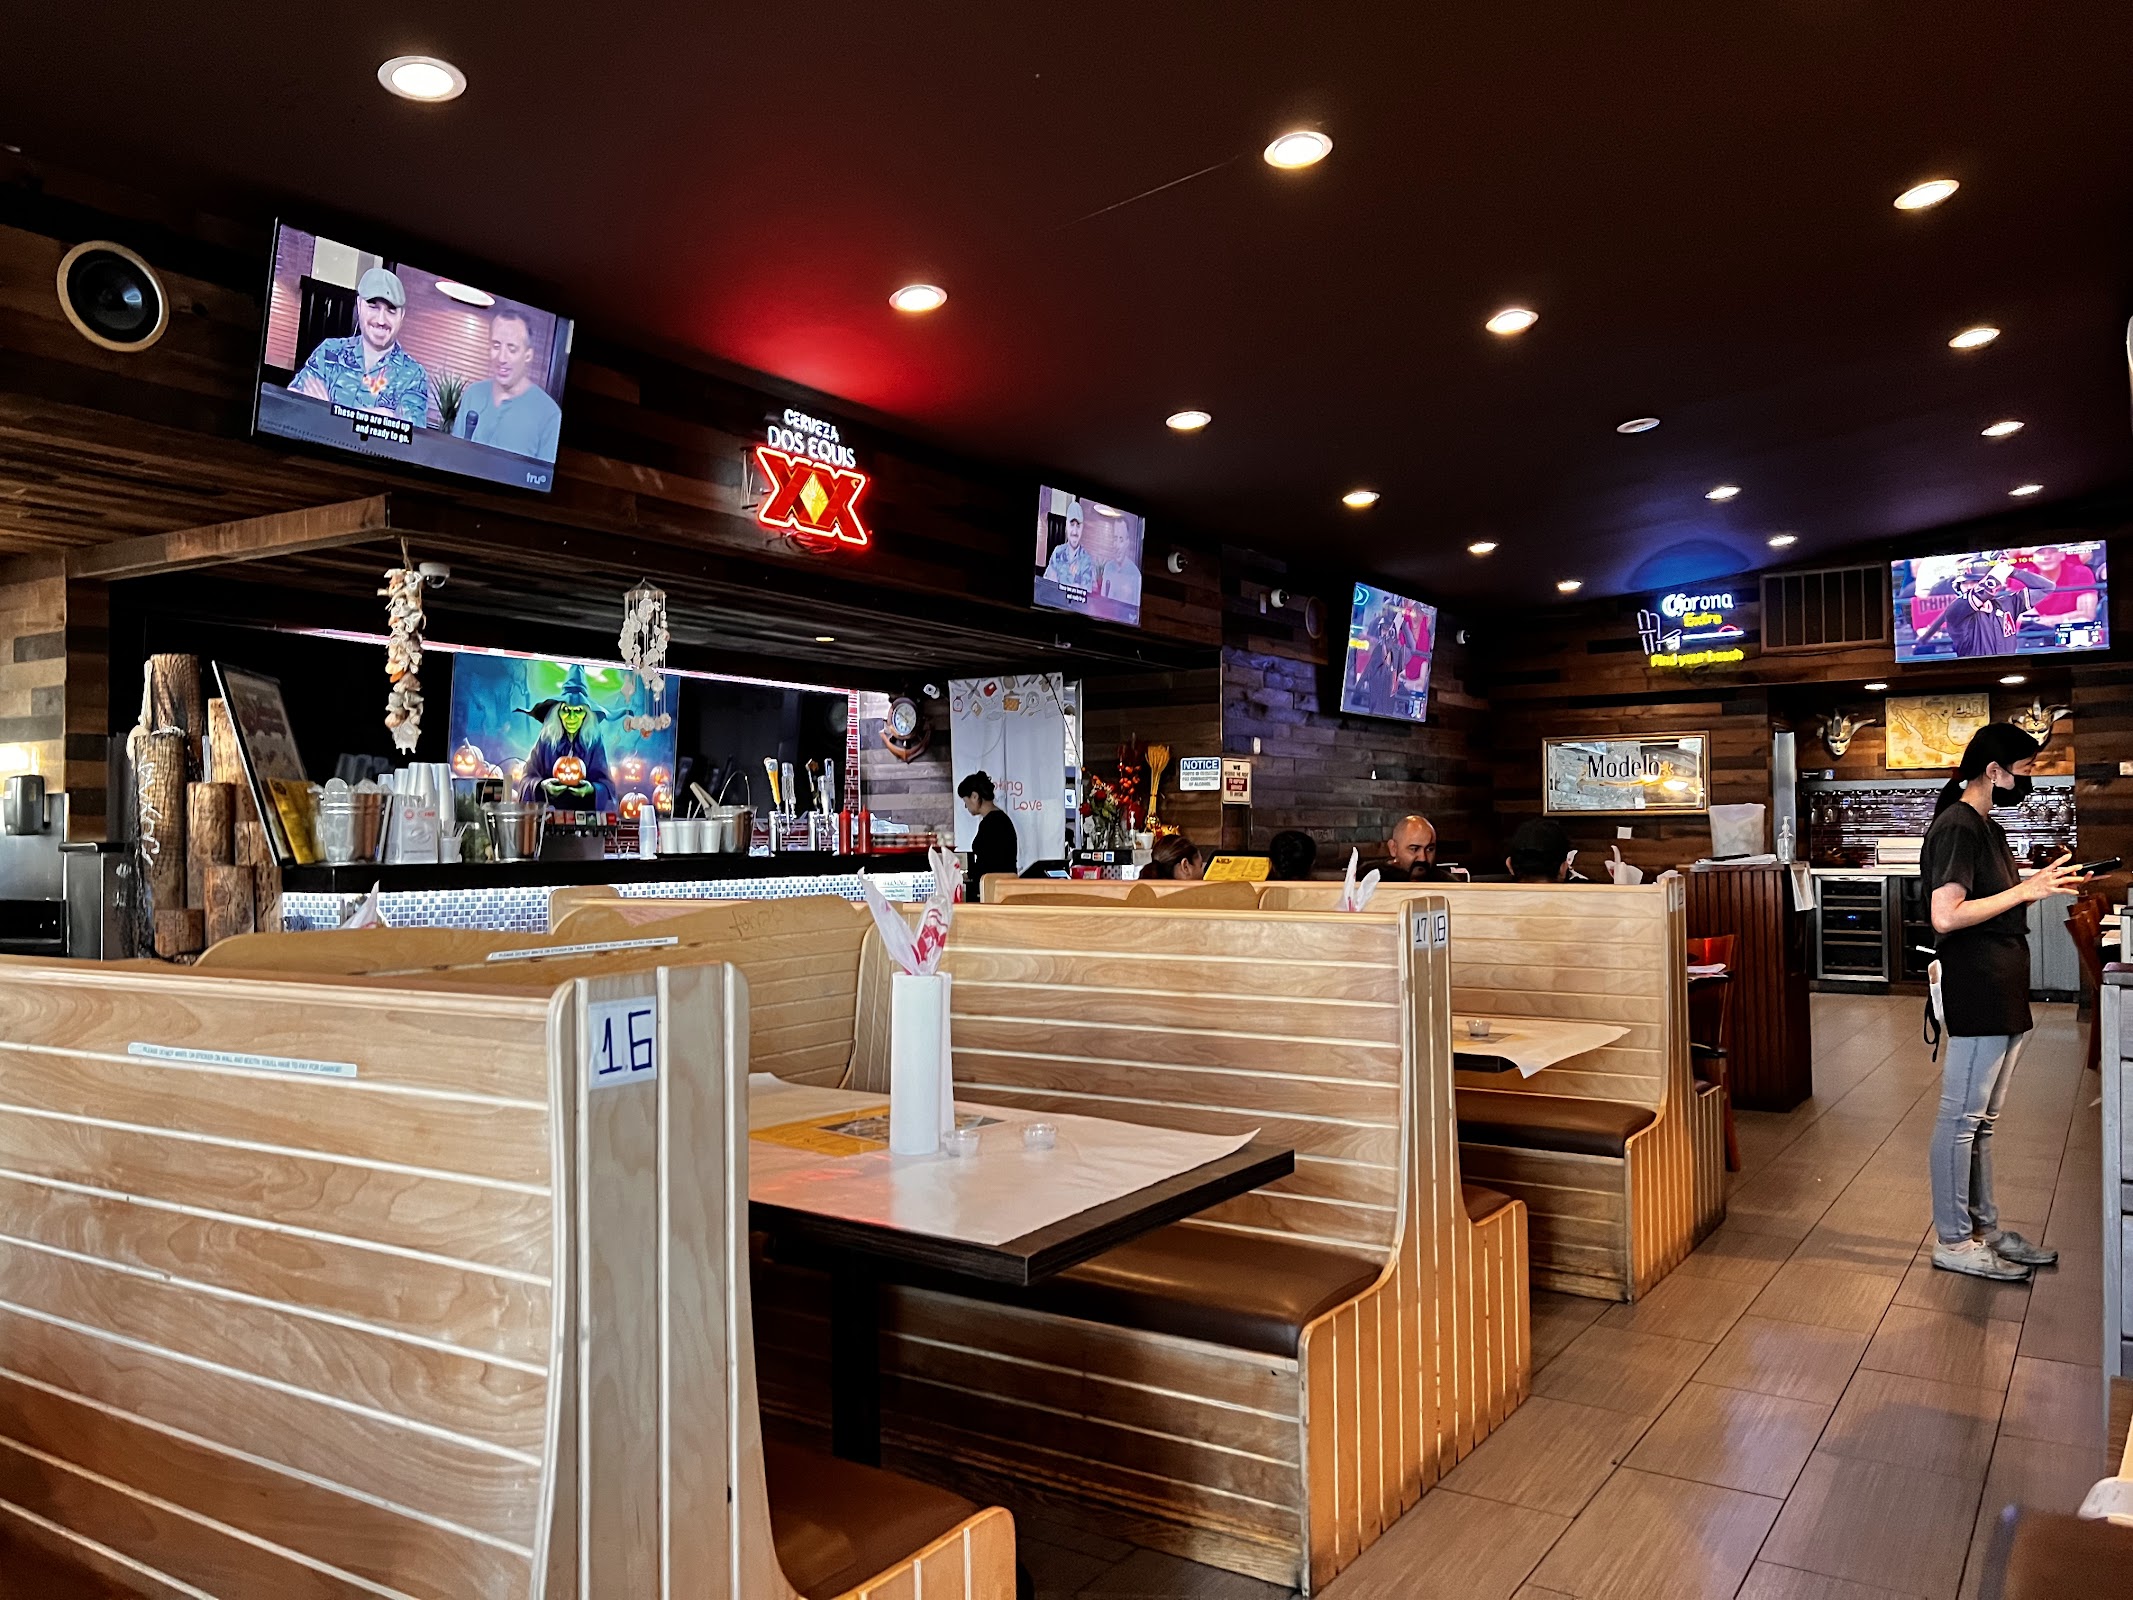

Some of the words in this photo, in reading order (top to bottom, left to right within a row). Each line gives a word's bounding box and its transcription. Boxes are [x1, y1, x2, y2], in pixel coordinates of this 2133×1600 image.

[333, 405, 355, 419] These
[356, 411, 369, 422] two
[370, 415, 382, 425] are
[383, 417, 400, 429] lined
[401, 423, 410, 432] up
[784, 408, 840, 442] CERVEZA
[355, 424, 369, 434] and
[370, 427, 390, 440] ready
[390, 431, 398, 440] to
[767, 425, 806, 455] DOS
[807, 436, 857, 470] EQUIS
[757, 446, 868, 545] XX
[1661, 592, 1735, 618] Corona
[1650, 653, 1679, 668] Find
[1678, 651, 1707, 668] your
[1706, 648, 1745, 664] beach
[1183, 760, 1219, 770] NOTICE
[1588, 753, 1662, 778] Modelo
[1013, 797, 1043, 811] Love
[1415, 917, 1428, 943] 17
[599, 1009, 653, 1075] 16
